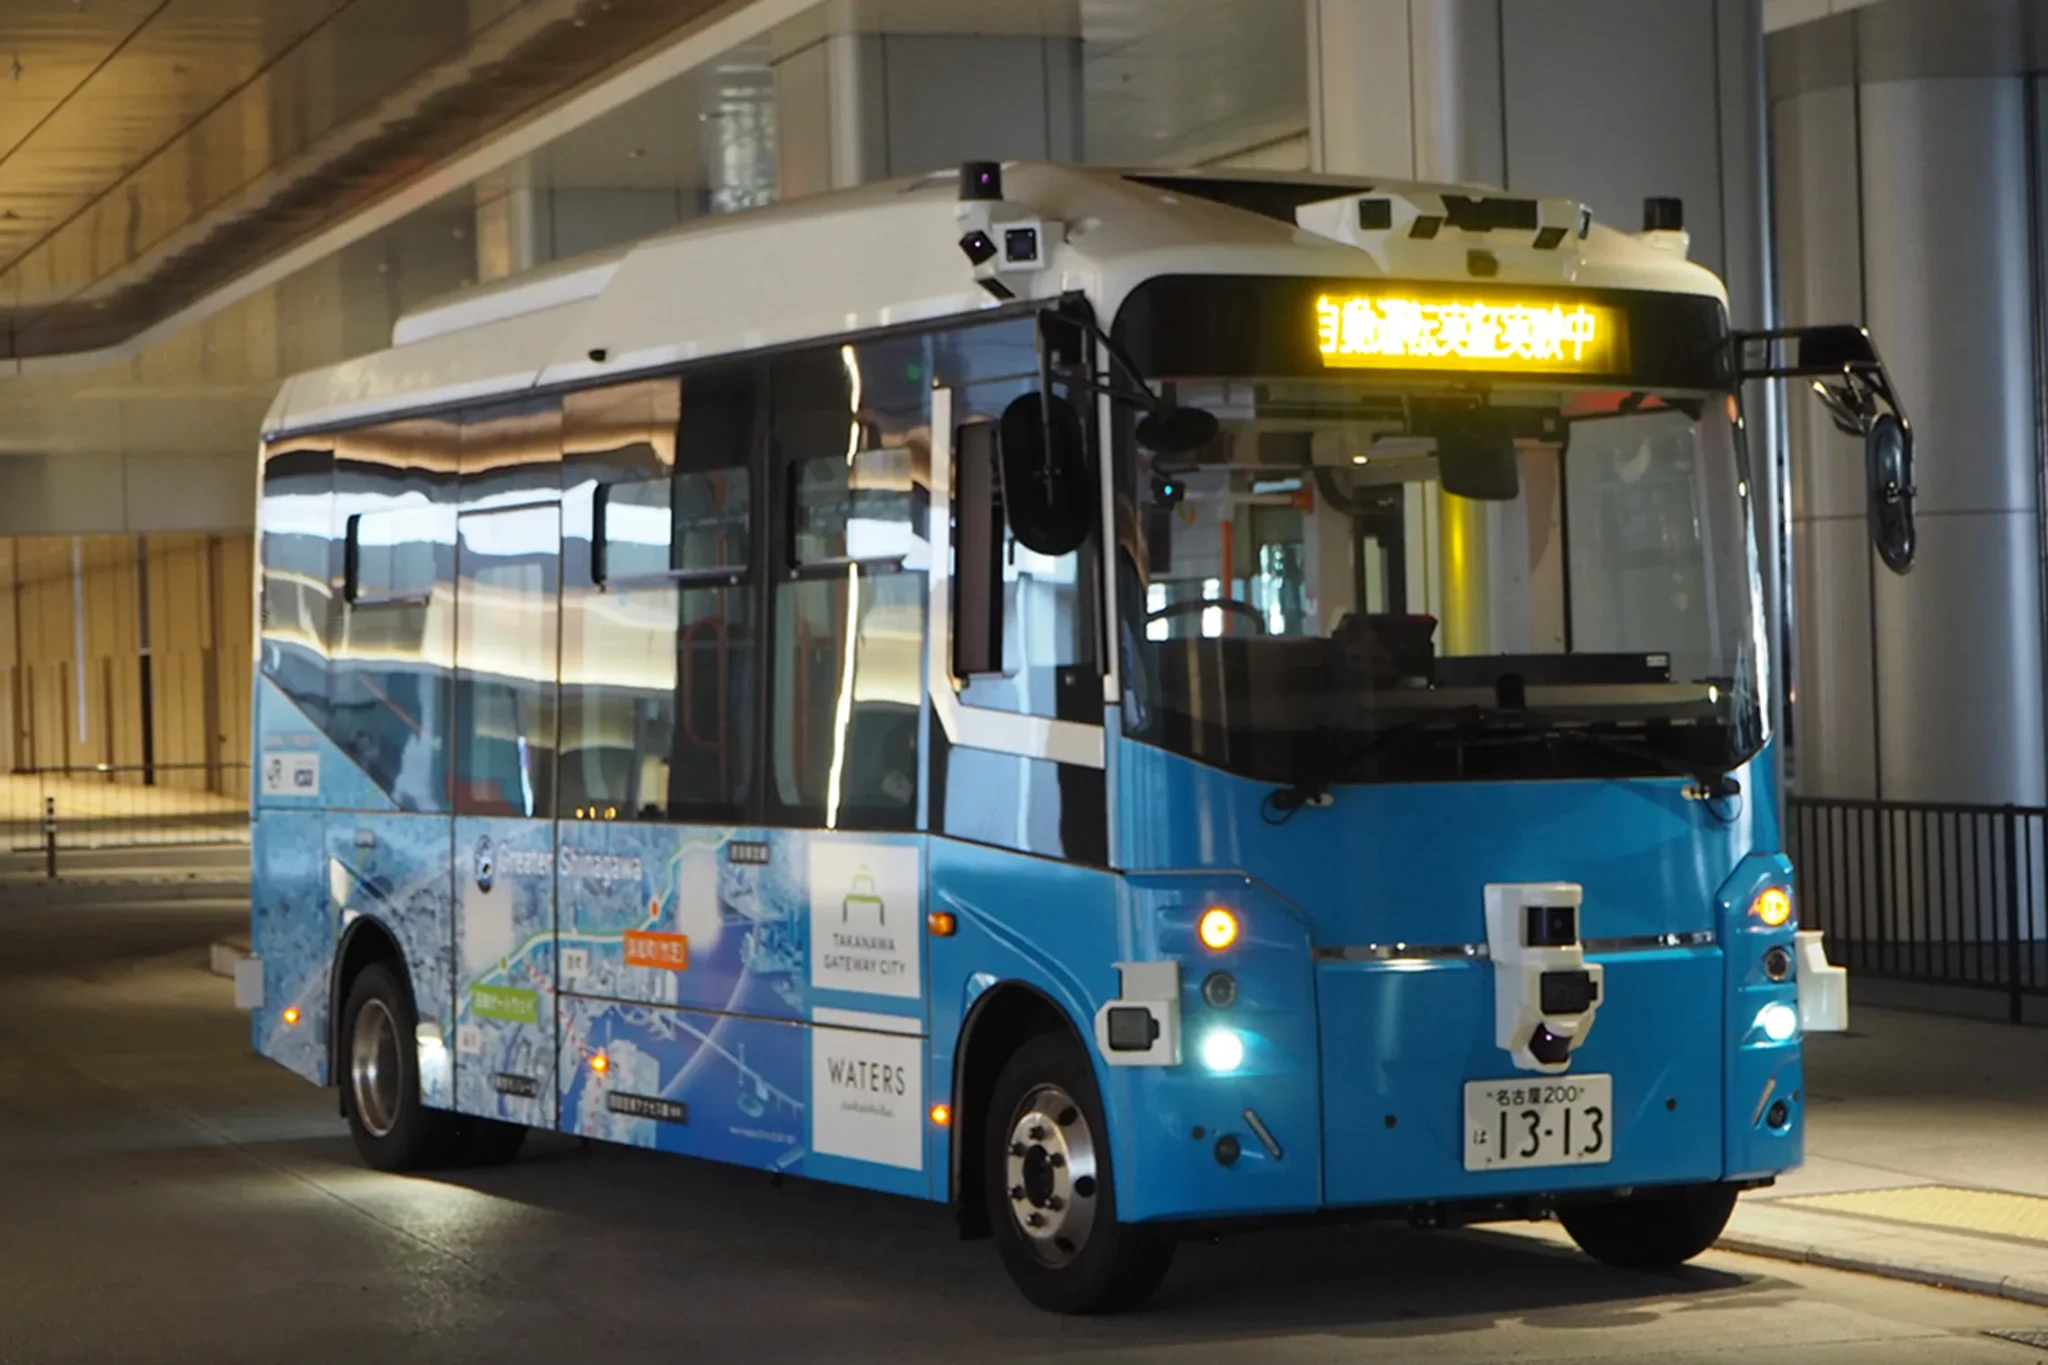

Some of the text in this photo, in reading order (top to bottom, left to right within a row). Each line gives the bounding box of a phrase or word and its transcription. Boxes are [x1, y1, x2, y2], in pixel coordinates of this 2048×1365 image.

[832, 931, 896, 951] TAKANAWA
[823, 953, 906, 976] GATEWAY CITY
[827, 1057, 906, 1096] WATERS
[1473, 1129, 1487, 1145] は
